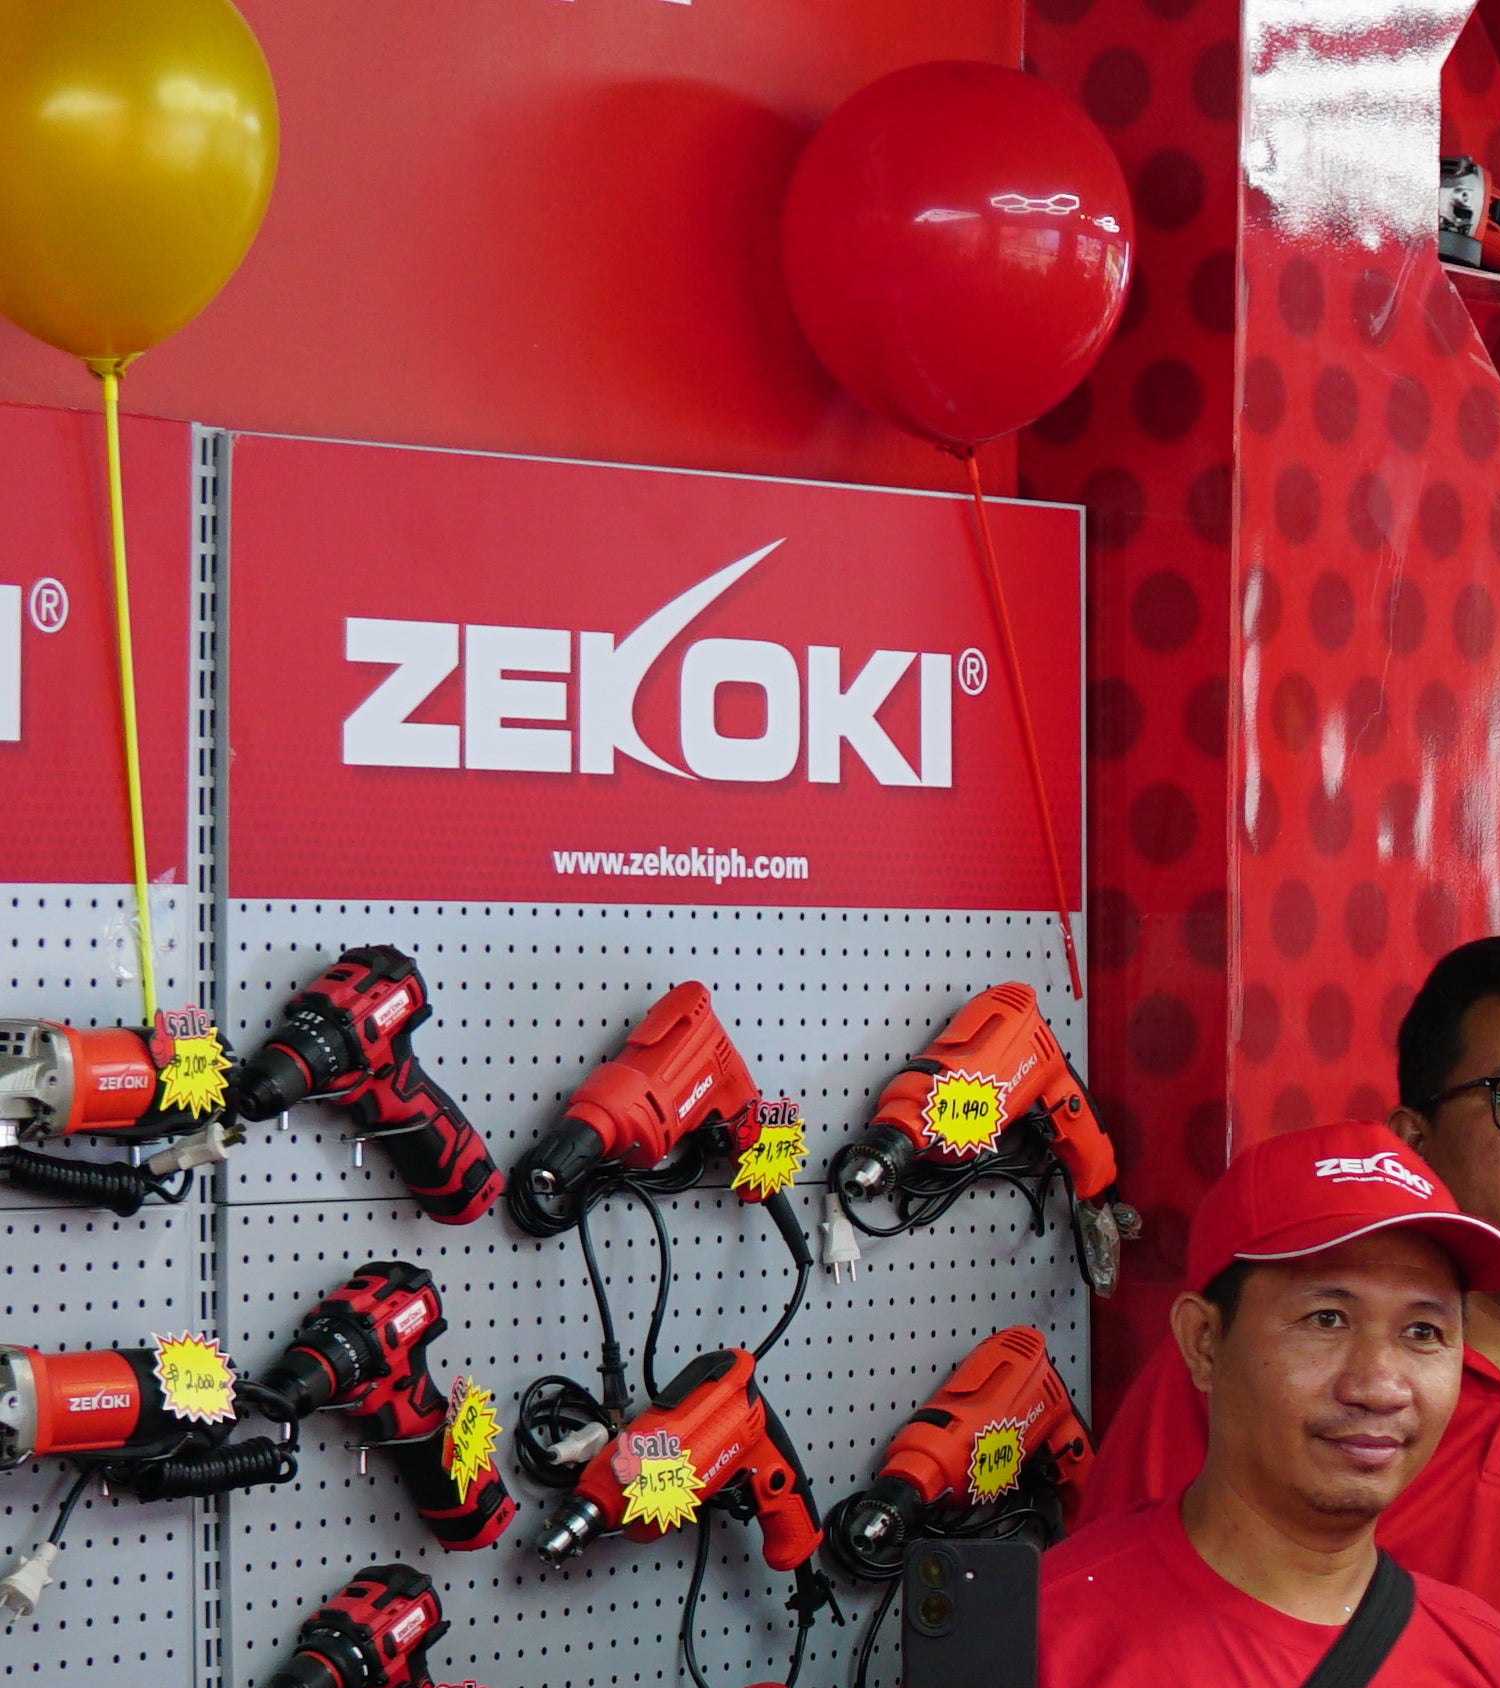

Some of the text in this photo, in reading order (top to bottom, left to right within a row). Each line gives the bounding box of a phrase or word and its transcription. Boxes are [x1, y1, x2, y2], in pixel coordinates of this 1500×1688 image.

[553, 846, 809, 885] www.zekokiph.com
[165, 1007, 209, 1040] sale
[99, 1063, 149, 1091] ZEKOKI
[678, 1074, 714, 1119] ZEKOKI
[758, 1100, 798, 1127] sale
[69, 1386, 131, 1412] ZEKOKI
[633, 1433, 682, 1458] sale
